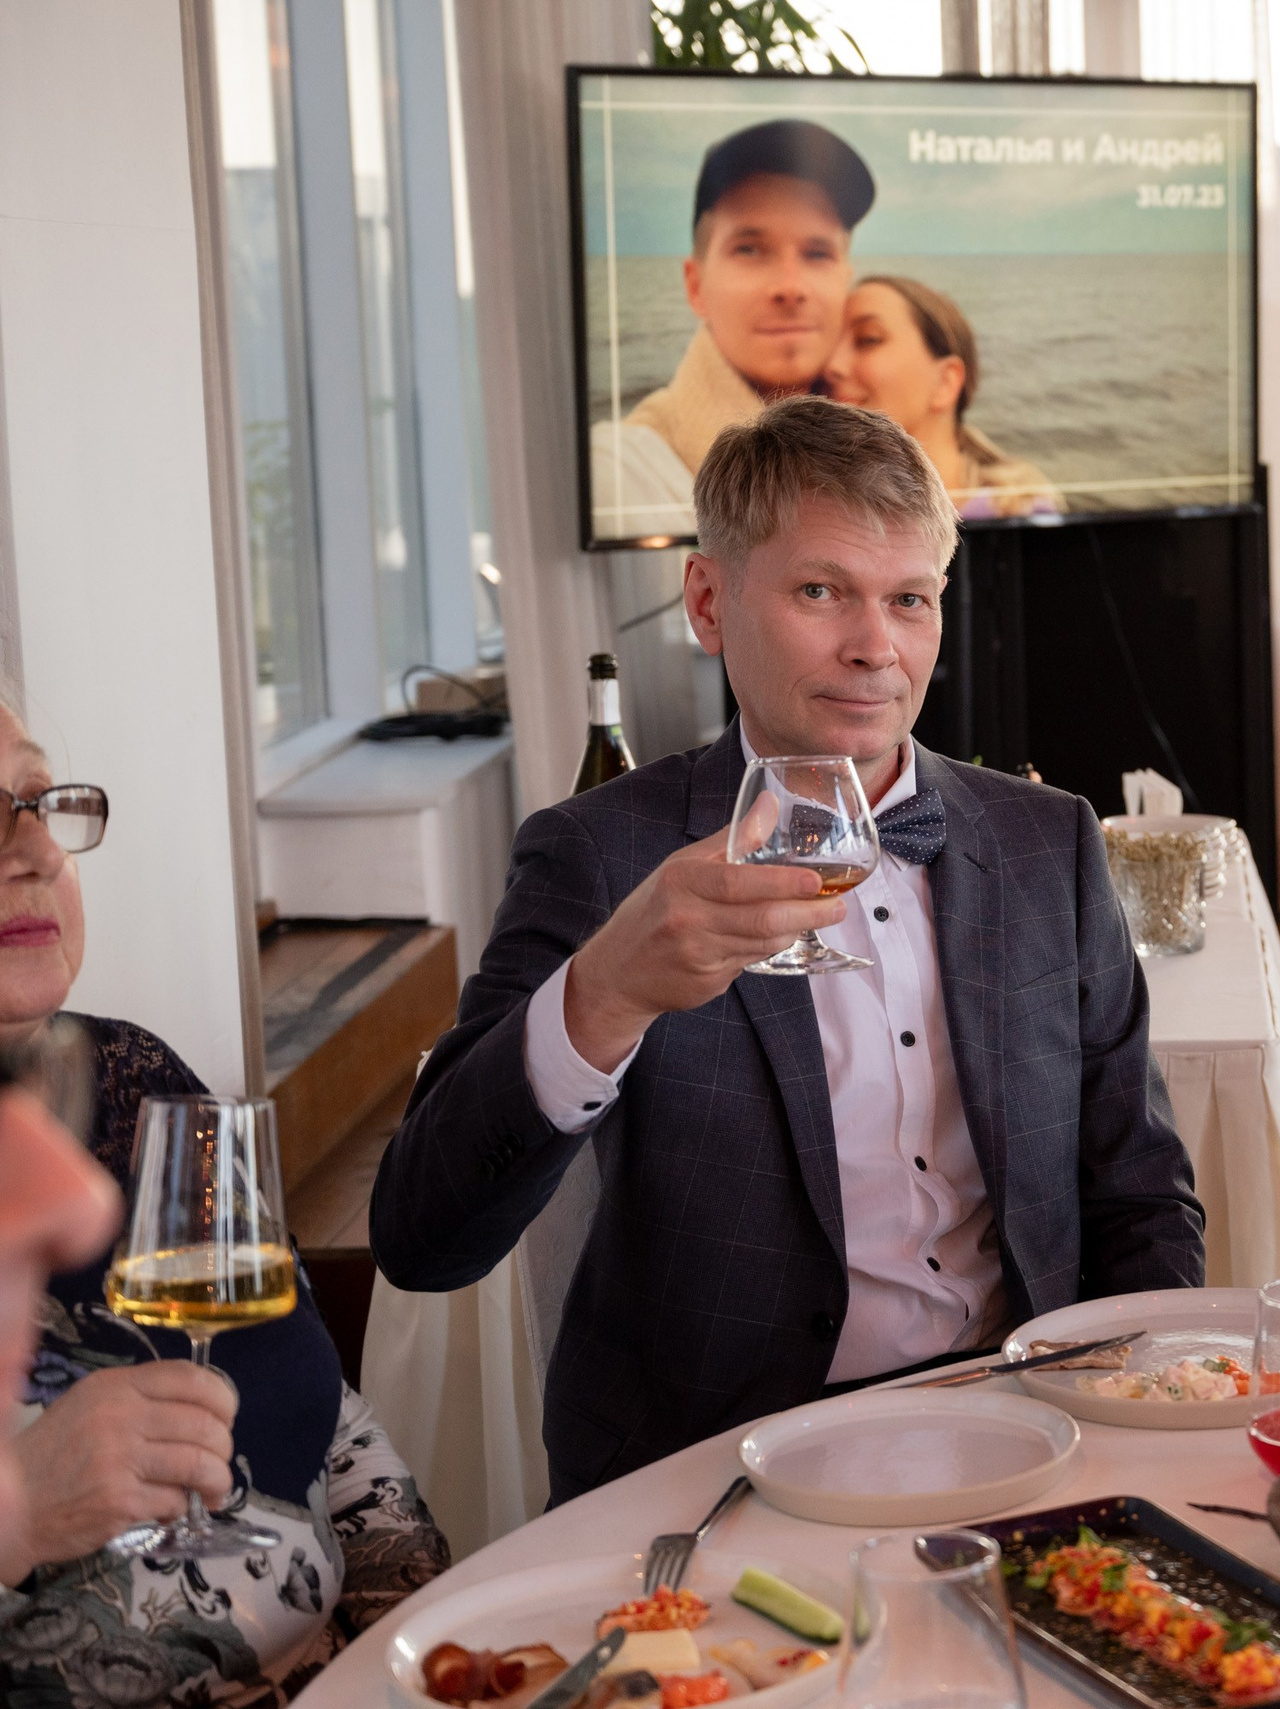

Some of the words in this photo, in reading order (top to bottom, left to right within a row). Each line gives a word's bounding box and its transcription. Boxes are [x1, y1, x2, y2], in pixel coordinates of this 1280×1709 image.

[908, 129, 1054, 164] Наталья
[1060, 137, 1086, 164] и
[1092, 132, 1225, 171] Андрей
